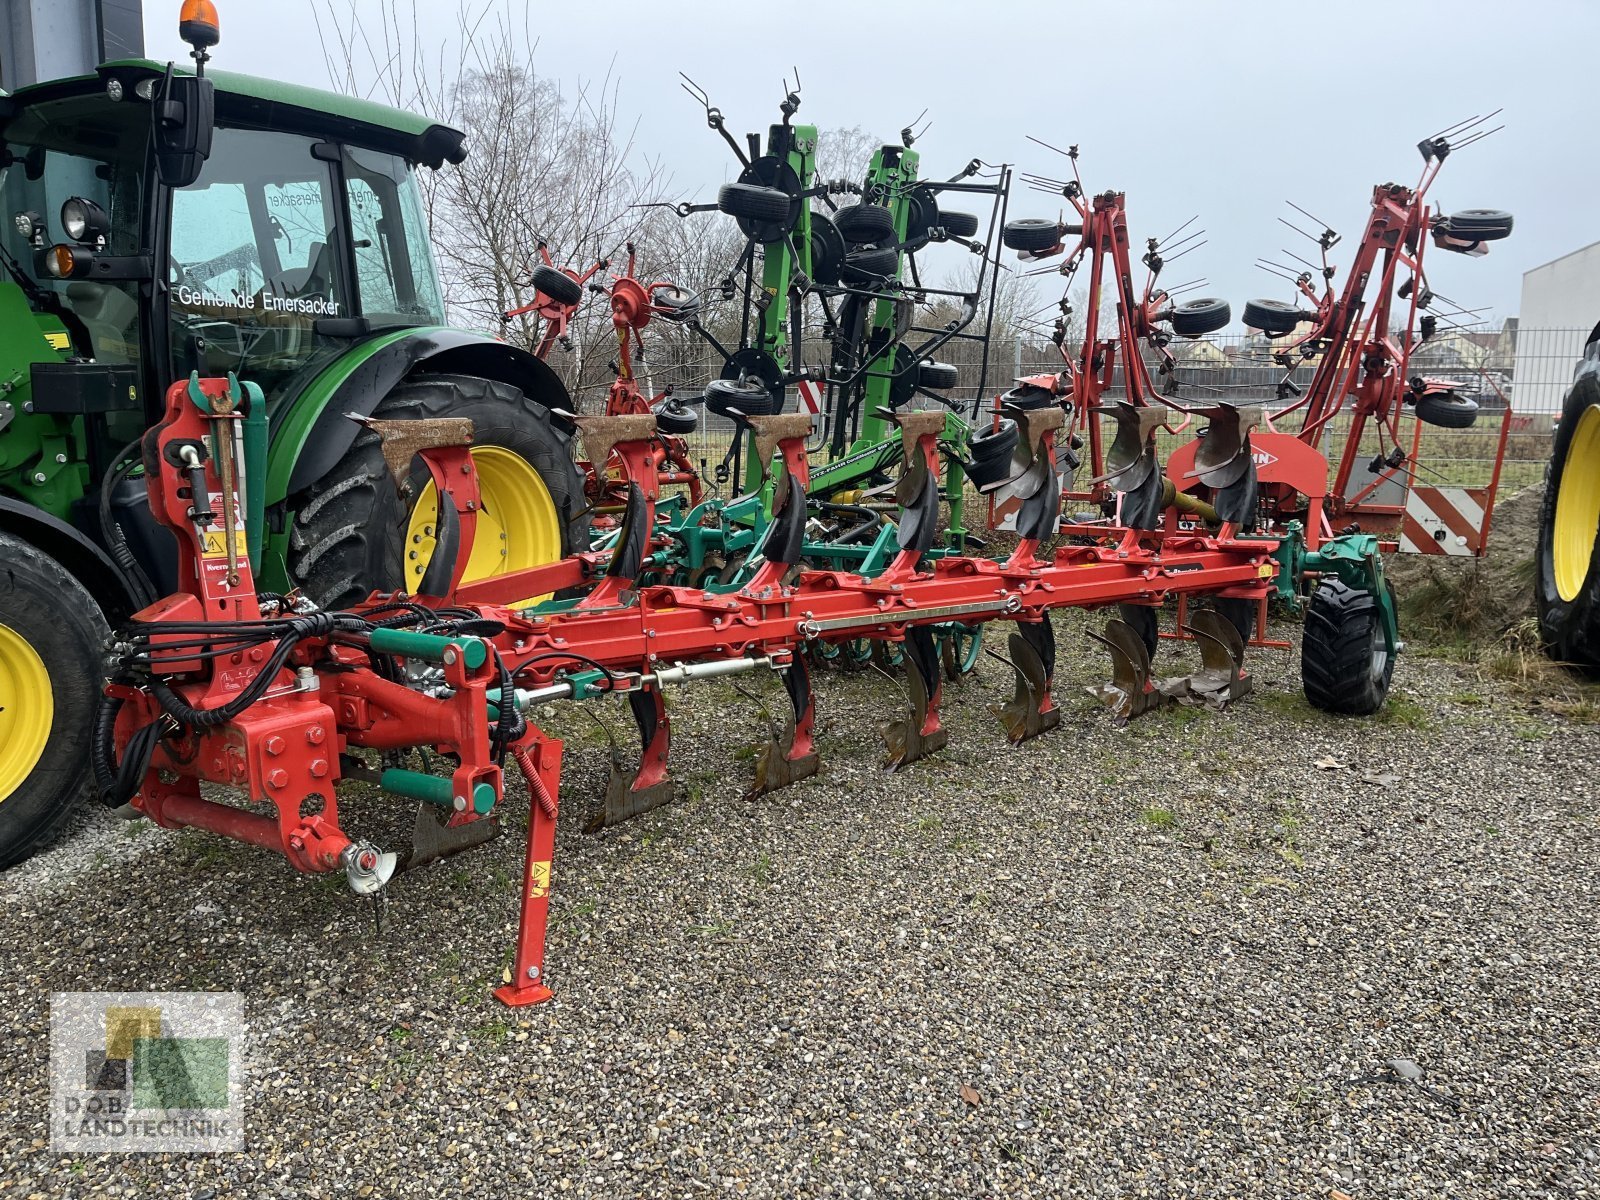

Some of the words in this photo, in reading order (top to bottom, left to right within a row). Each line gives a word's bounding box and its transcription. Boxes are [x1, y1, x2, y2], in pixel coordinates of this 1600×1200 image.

[178, 285, 255, 309] Gemeinde
[262, 292, 340, 316] Emersacker
[809, 461, 846, 480] UTZ-FAHR
[206, 561, 247, 572] Kvernnd
